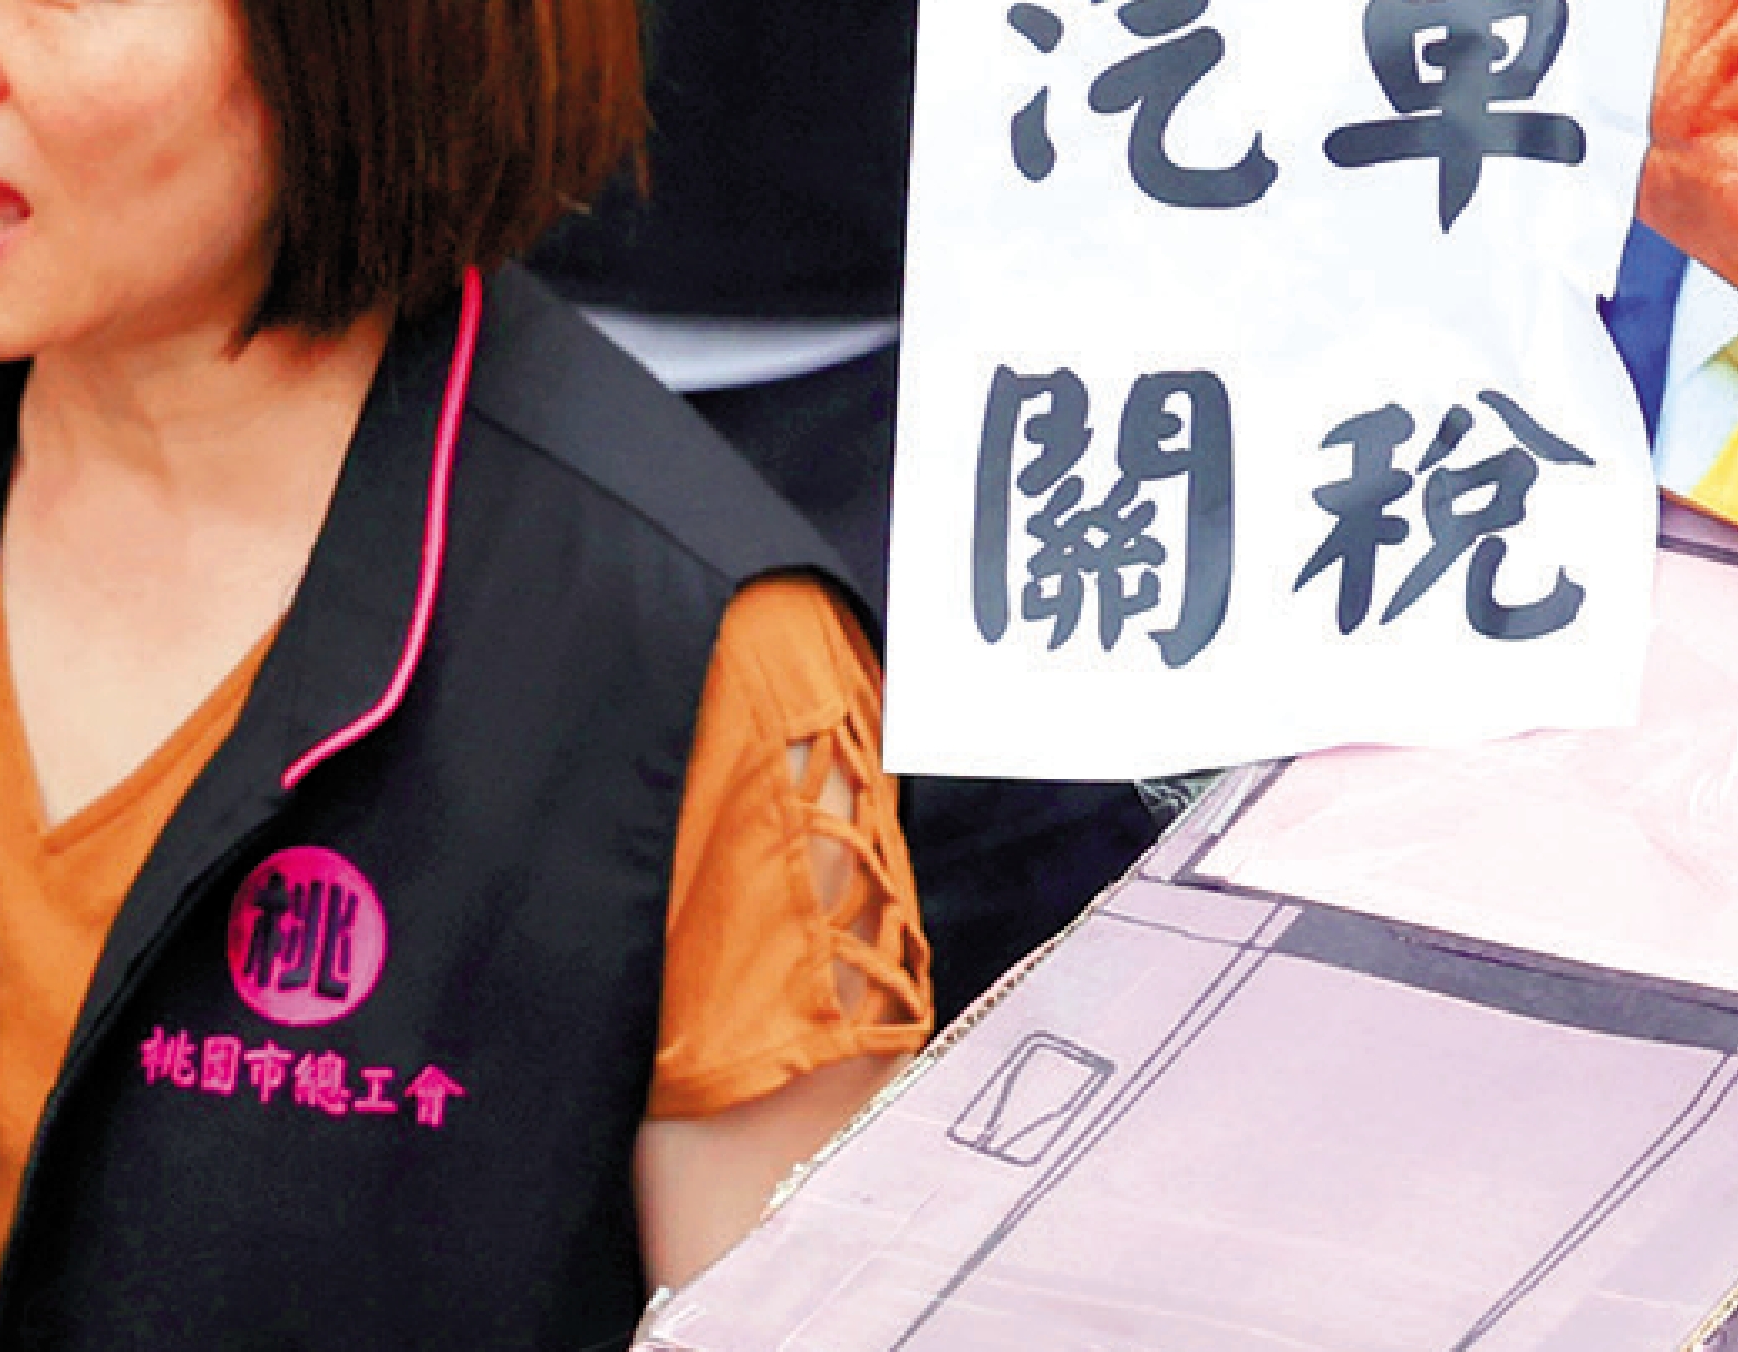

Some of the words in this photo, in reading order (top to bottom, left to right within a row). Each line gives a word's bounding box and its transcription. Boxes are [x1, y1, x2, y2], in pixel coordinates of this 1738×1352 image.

[971, 362, 1597, 669] 關稅
[139, 1024, 467, 1129] 桃園市總工會
